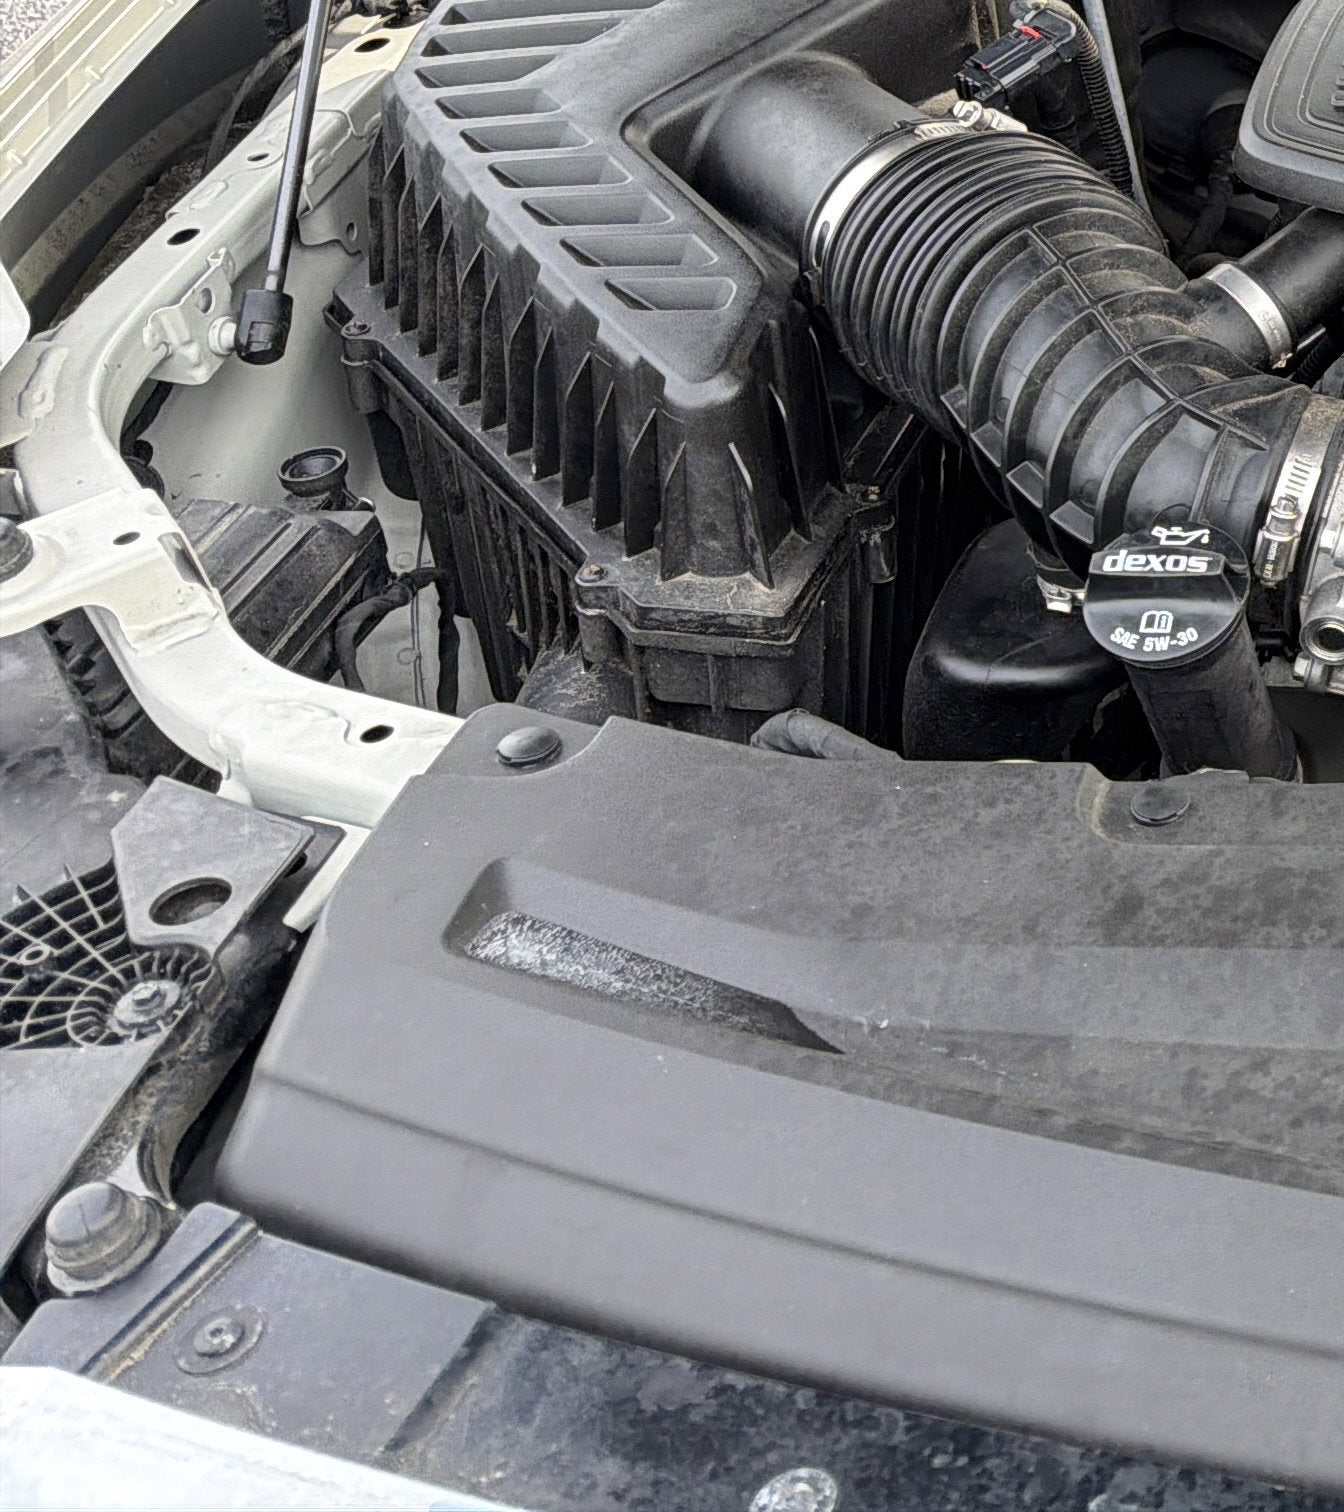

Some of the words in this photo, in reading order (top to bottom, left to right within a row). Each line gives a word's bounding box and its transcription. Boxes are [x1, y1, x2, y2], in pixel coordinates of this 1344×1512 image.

[1102, 549, 1214, 573] dexos
[1110, 627, 1141, 650] SAE
[1142, 627, 1199, 652] 5W-30
